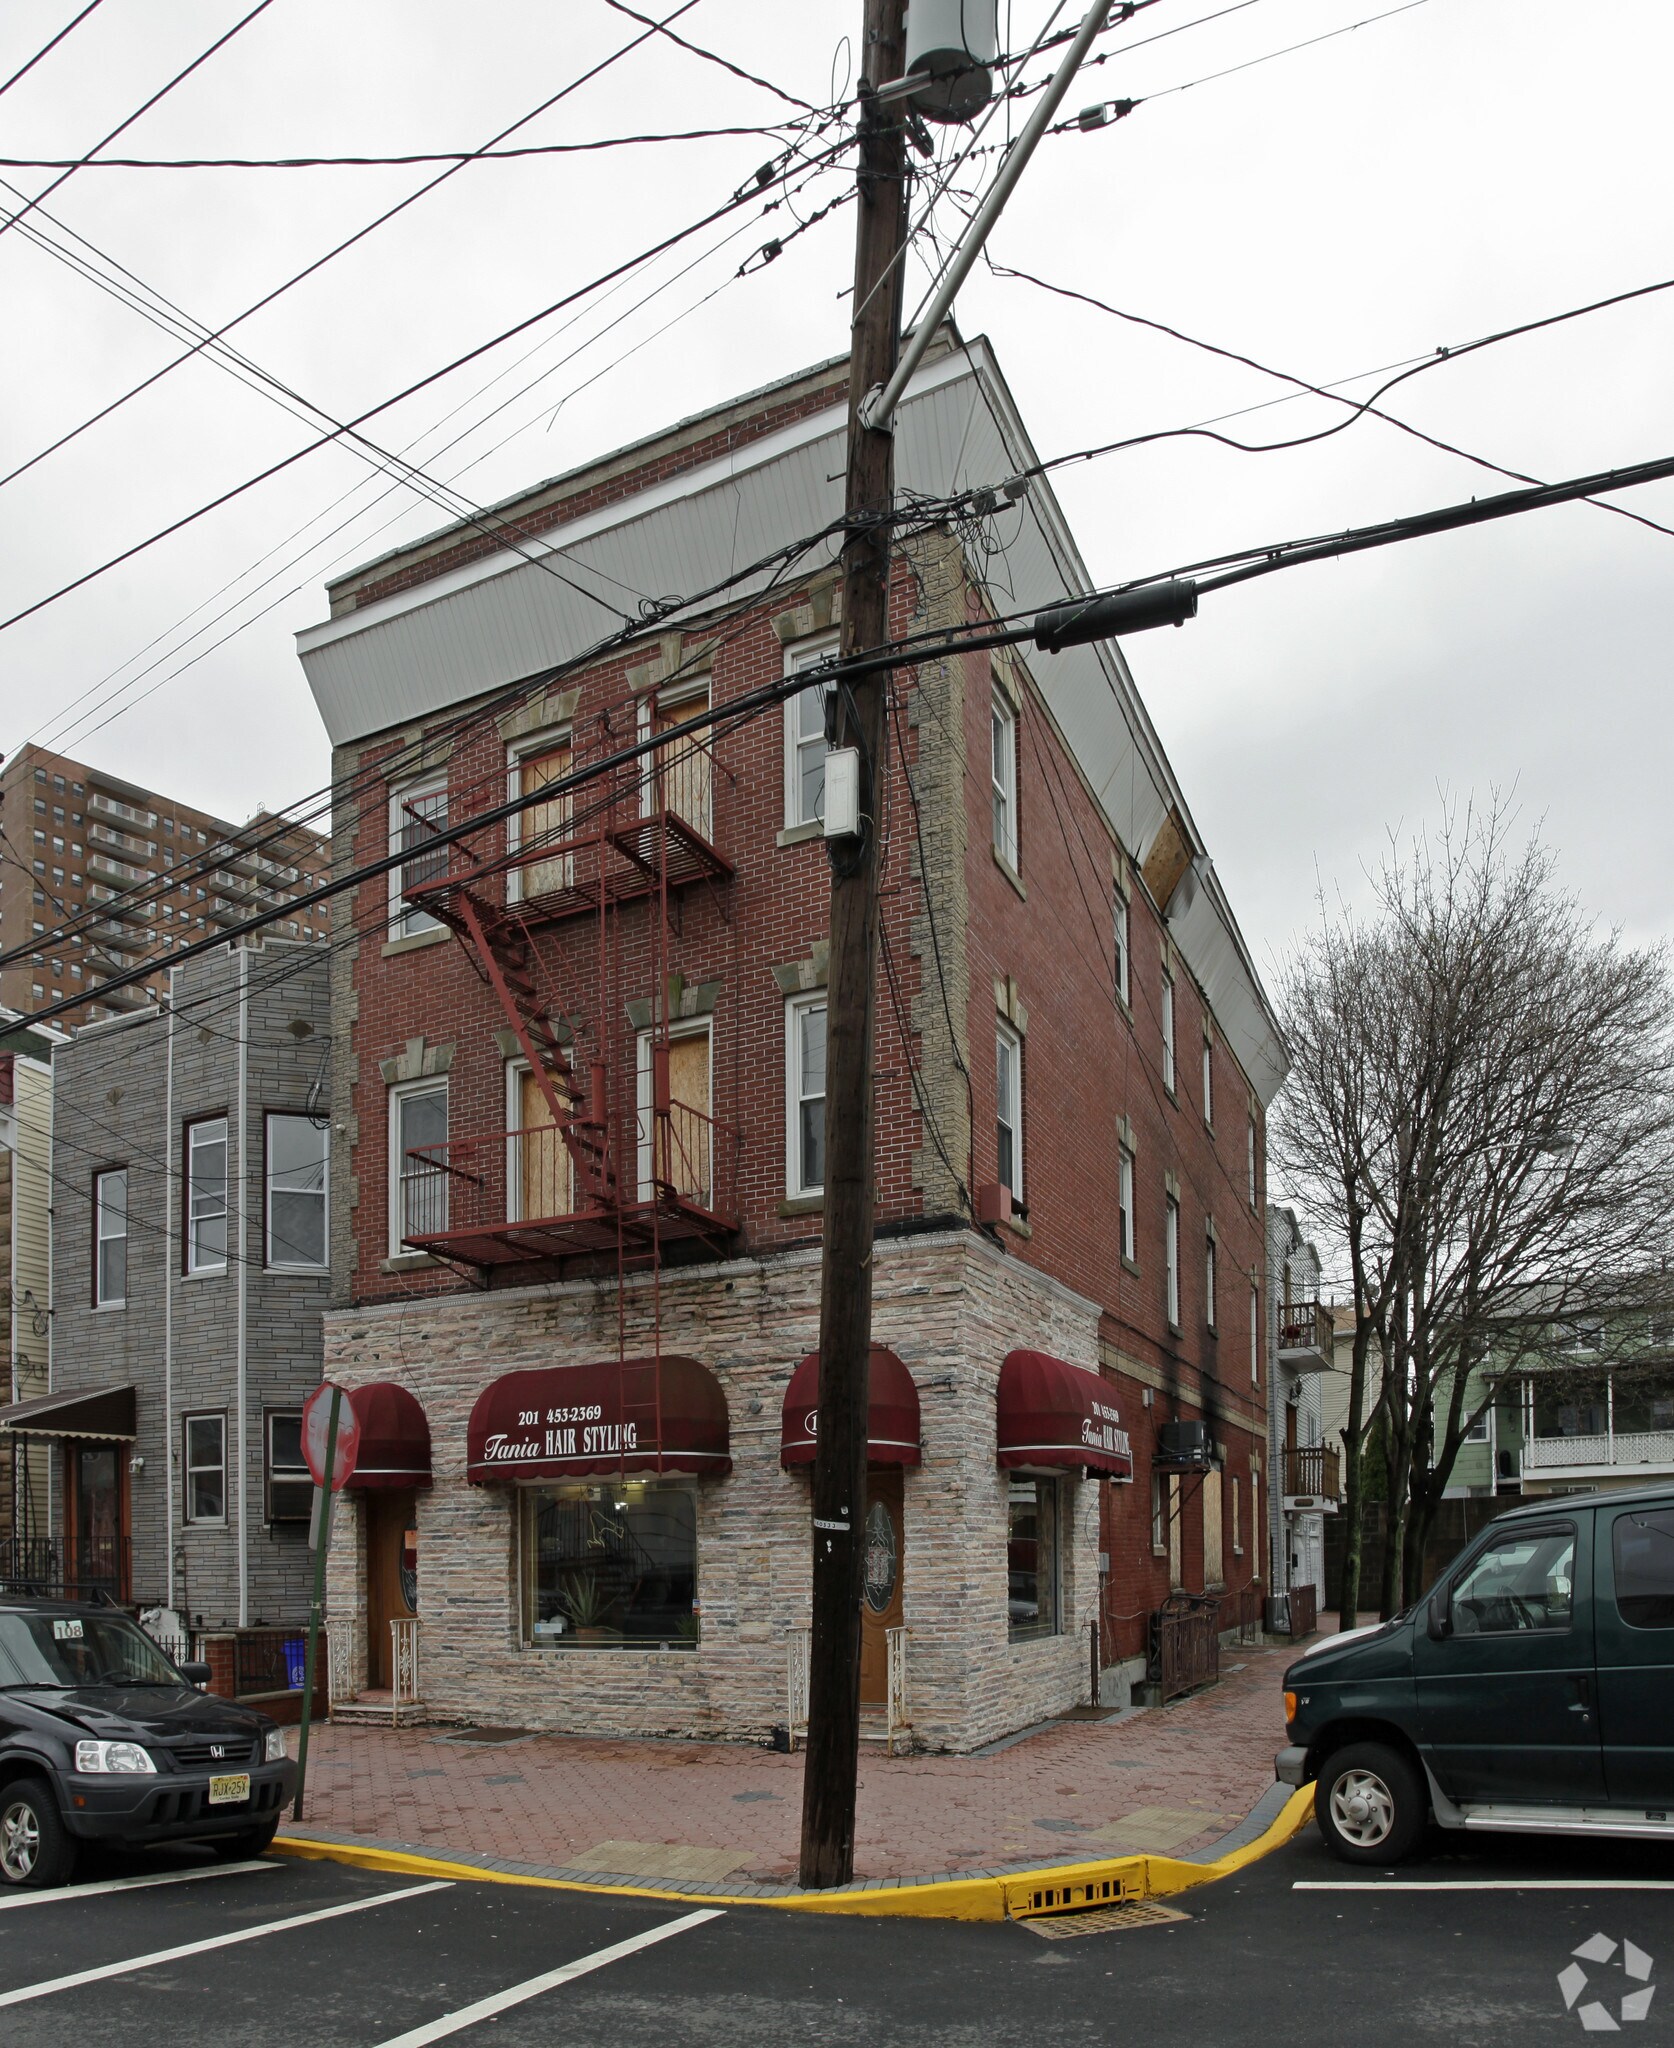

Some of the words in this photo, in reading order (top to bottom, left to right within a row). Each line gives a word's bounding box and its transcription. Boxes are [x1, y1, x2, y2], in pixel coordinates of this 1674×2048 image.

[518, 1410, 539, 1426] 201
[546, 1404, 602, 1424] 453-2369
[484, 1433, 542, 1461] Tania
[545, 1427, 577, 1456] HAIR
[583, 1422, 638, 1453] STYLING
[1082, 1418, 1102, 1447] Tania
[56, 1625, 83, 1640] 108
